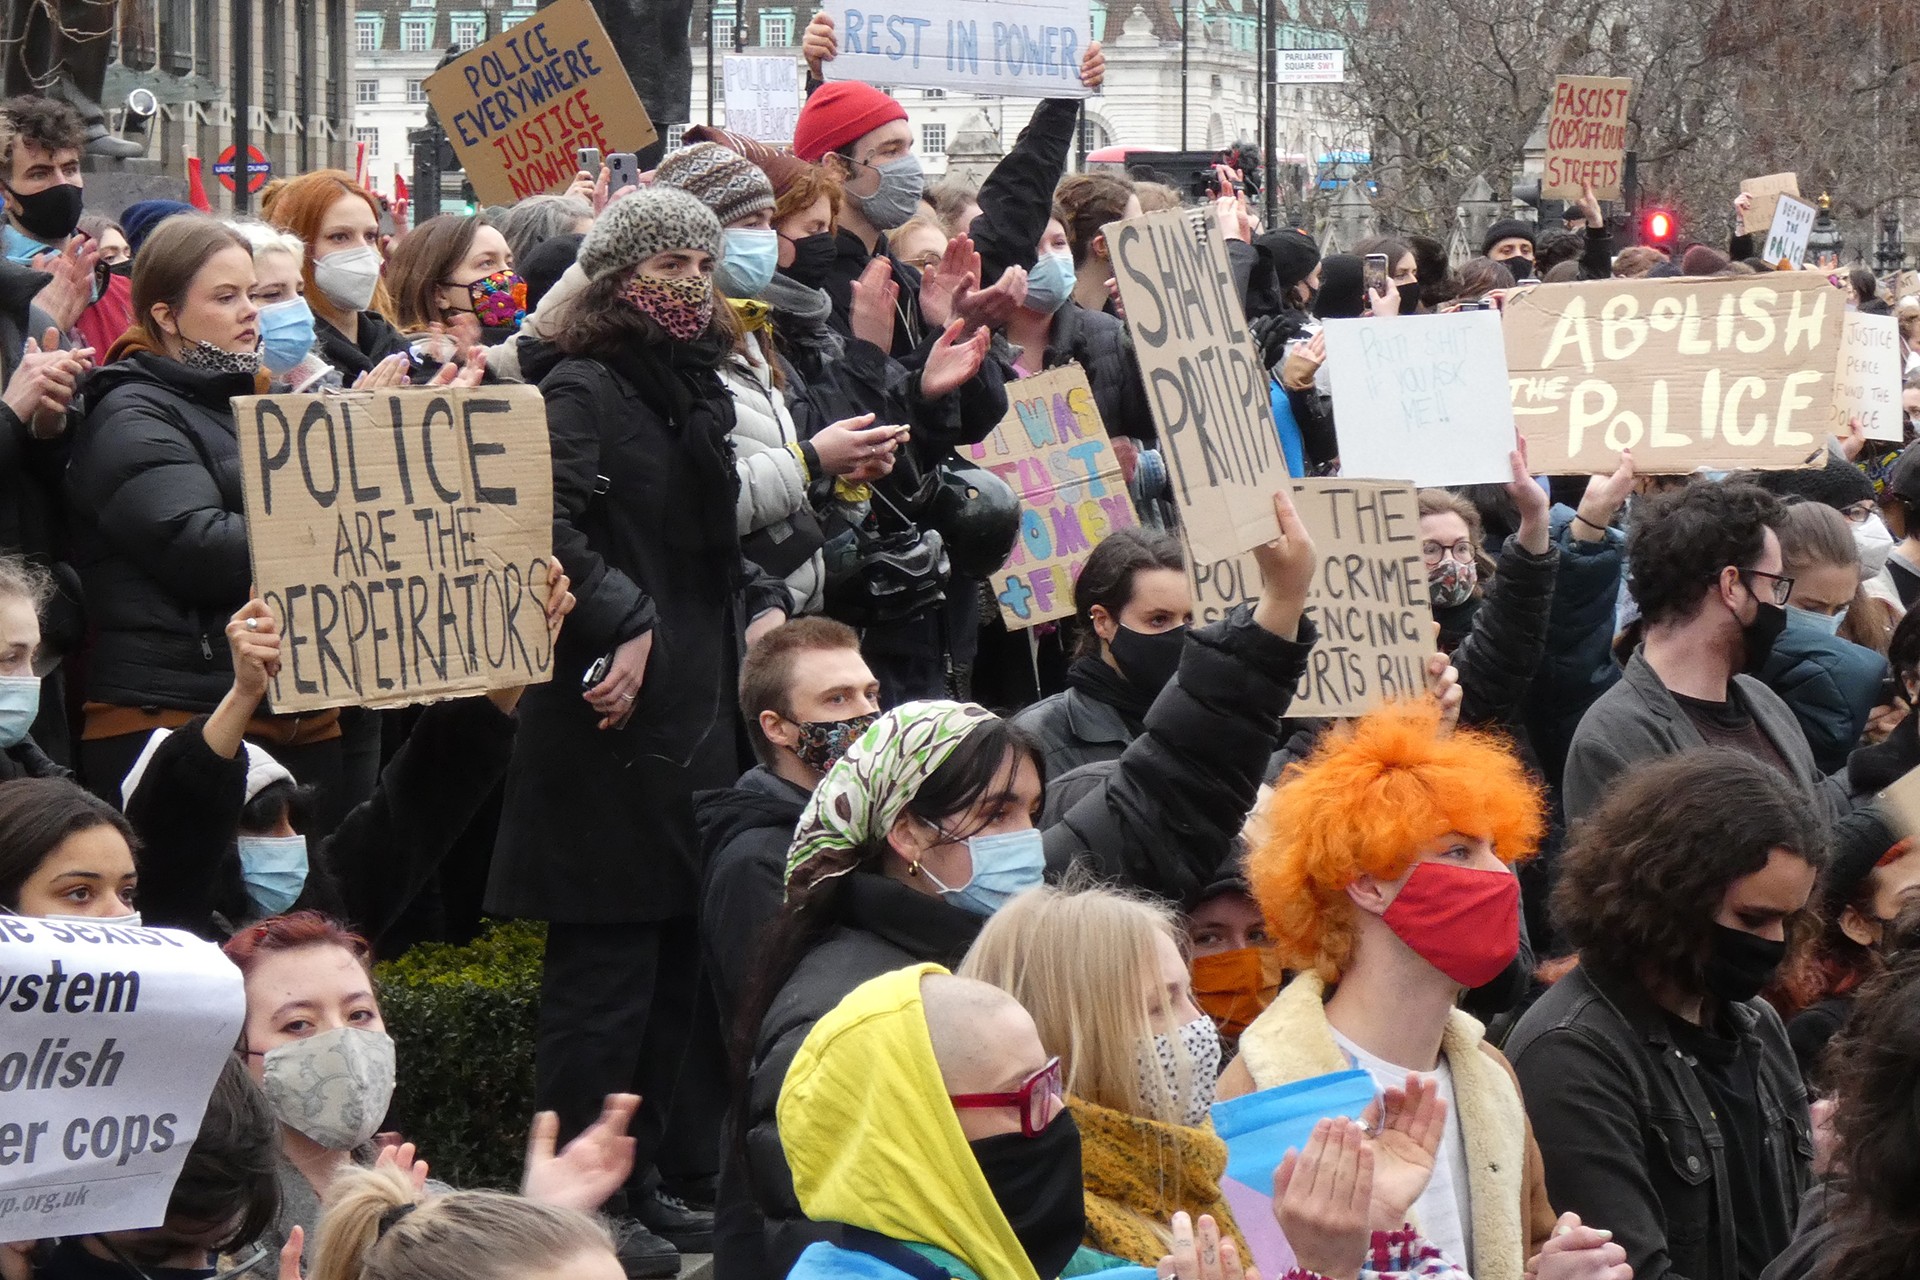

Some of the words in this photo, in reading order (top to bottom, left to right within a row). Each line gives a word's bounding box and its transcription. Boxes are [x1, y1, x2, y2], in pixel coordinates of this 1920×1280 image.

[464, 22, 558, 97] POLICE
[844, 8, 931, 69] REST
[947, 19, 978, 75] IN
[993, 21, 1083, 80] POWER
[1285, 62, 1315, 70] SQUARE
[1317, 62, 1334, 70] SW1
[453, 39, 602, 147] EVERYWHERE
[1555, 83, 1627, 118] FASCIST
[493, 88, 599, 170] JUSTICE
[215, 165, 269, 173] UNDEOUND
[1549, 156, 1617, 188] STREETS
[1786, 220, 1799, 234] THE
[1118, 215, 1246, 348] SHAME
[1425, 326, 1473, 356] SHIT
[1541, 286, 1828, 373] ABOLISH
[1847, 322, 1892, 349] JUSTICE
[1393, 366, 1427, 394] YOU
[1431, 359, 1467, 388] ASK
[1846, 356, 1879, 376] PEACE
[1871, 387, 1890, 403] THE
[1014, 387, 1101, 448] WAS
[1150, 346, 1257, 507] PRITI
[1508, 375, 1569, 403] THE
[1568, 368, 1824, 458] POLICE
[254, 396, 518, 516] POLICE
[333, 510, 401, 577] ARE
[413, 505, 484, 572] THE
[1003, 494, 1133, 570] OMEN
[1319, 488, 1416, 545] THE
[264, 557, 551, 702] PERPETRATORS
[38, 920, 185, 949] sexist
[62, 1112, 179, 1168] cops
